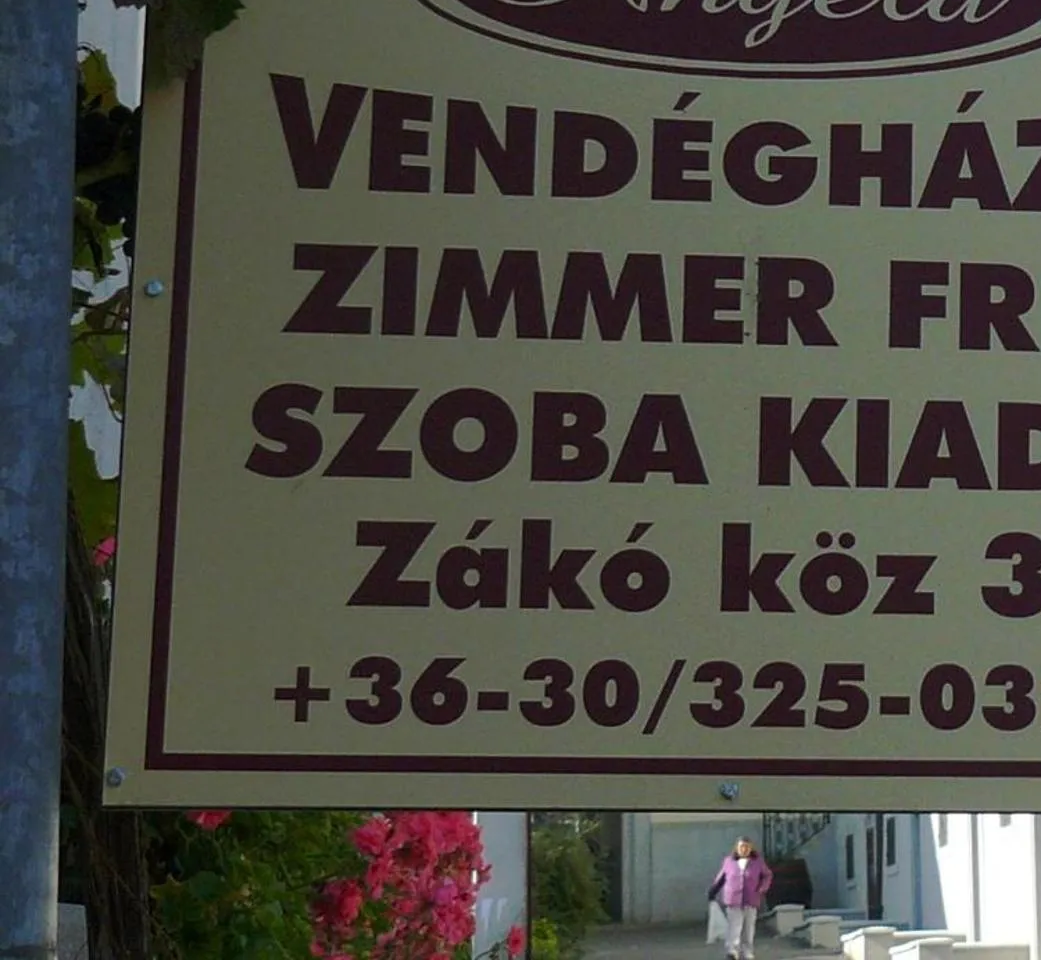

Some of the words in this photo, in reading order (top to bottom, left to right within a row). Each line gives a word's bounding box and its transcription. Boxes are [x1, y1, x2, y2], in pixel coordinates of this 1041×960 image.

[281, 244, 840, 347] ZIMMER
[247, 383, 710, 485] SZOBA
[345, 518, 671, 614] Zákó
[719, 522, 938, 617] köz
